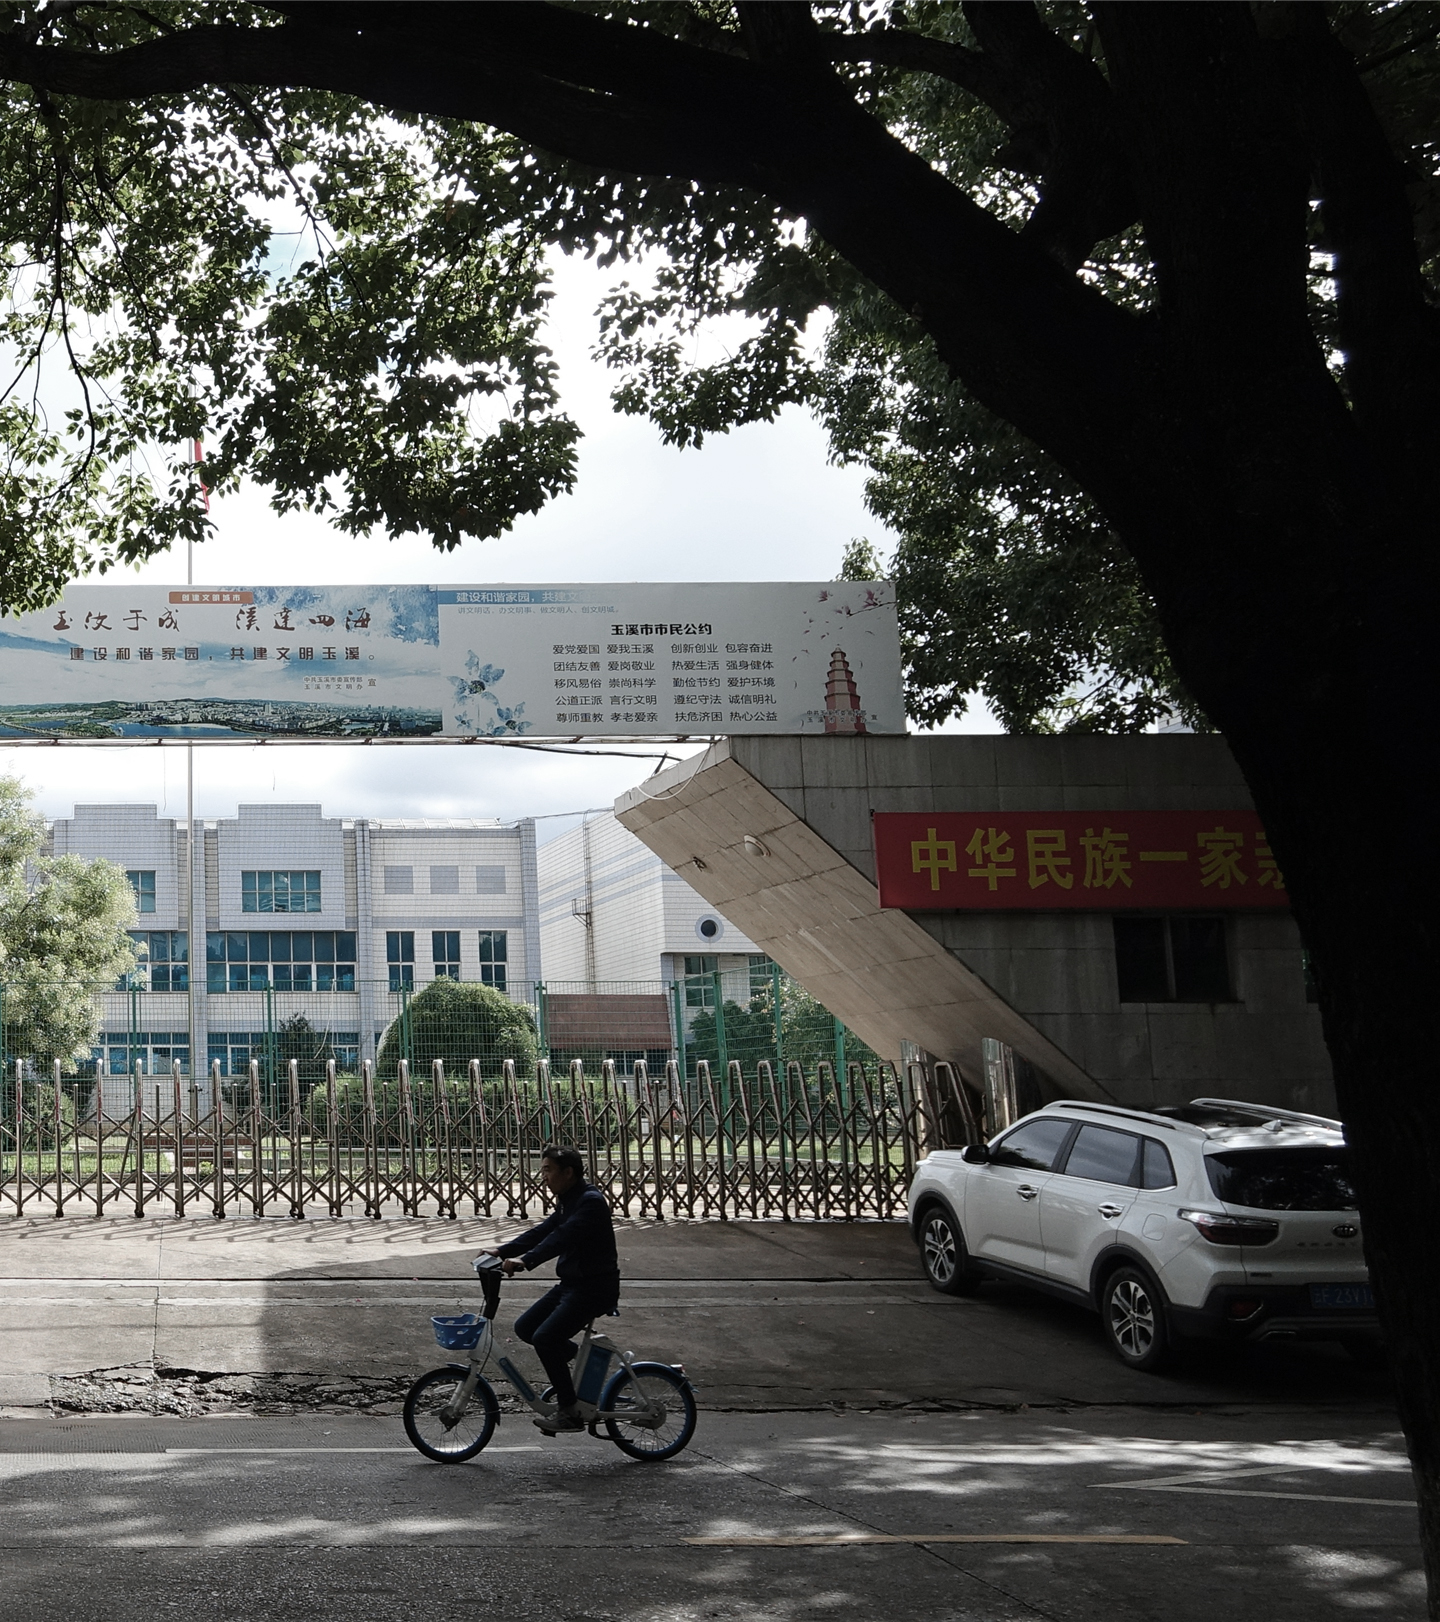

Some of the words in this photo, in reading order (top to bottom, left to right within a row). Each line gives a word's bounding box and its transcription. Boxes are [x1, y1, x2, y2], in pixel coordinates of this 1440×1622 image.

[182, 594, 240, 602] 创建文明城市
[456, 591, 590, 602] 建设和谐家园，共建文
[612, 624, 712, 635] 玉溪市市民公约
[70, 646, 376, 661] 建设和谐家园，共建文明玉溪。
[553, 645, 599, 654] 爱党爱国
[607, 644, 654, 654] 爱我玉溪
[671, 643, 718, 653] 创新创业
[725, 643, 772, 653] 包容奋进
[554, 661, 600, 671] 团结友善
[608, 661, 655, 671] 爱岗敬业
[672, 661, 719, 670] 热爱生活
[726, 660, 774, 670] 强身健体
[555, 679, 601, 688] 移风易俗
[609, 678, 656, 688] 崇尚科学
[673, 677, 720, 687] 勤俭节约
[728, 677, 775, 687] 爱护环境
[555, 696, 602, 705] 公道正派
[610, 695, 657, 705] 言行文明
[674, 695, 721, 704] 遵纪守法
[729, 694, 776, 704] 诚信明礼
[557, 713, 604, 723] 尊师重教
[611, 712, 657, 722] 孝老爱亲
[675, 712, 722, 722] 扶危济困
[730, 711, 777, 721] 热心公益
